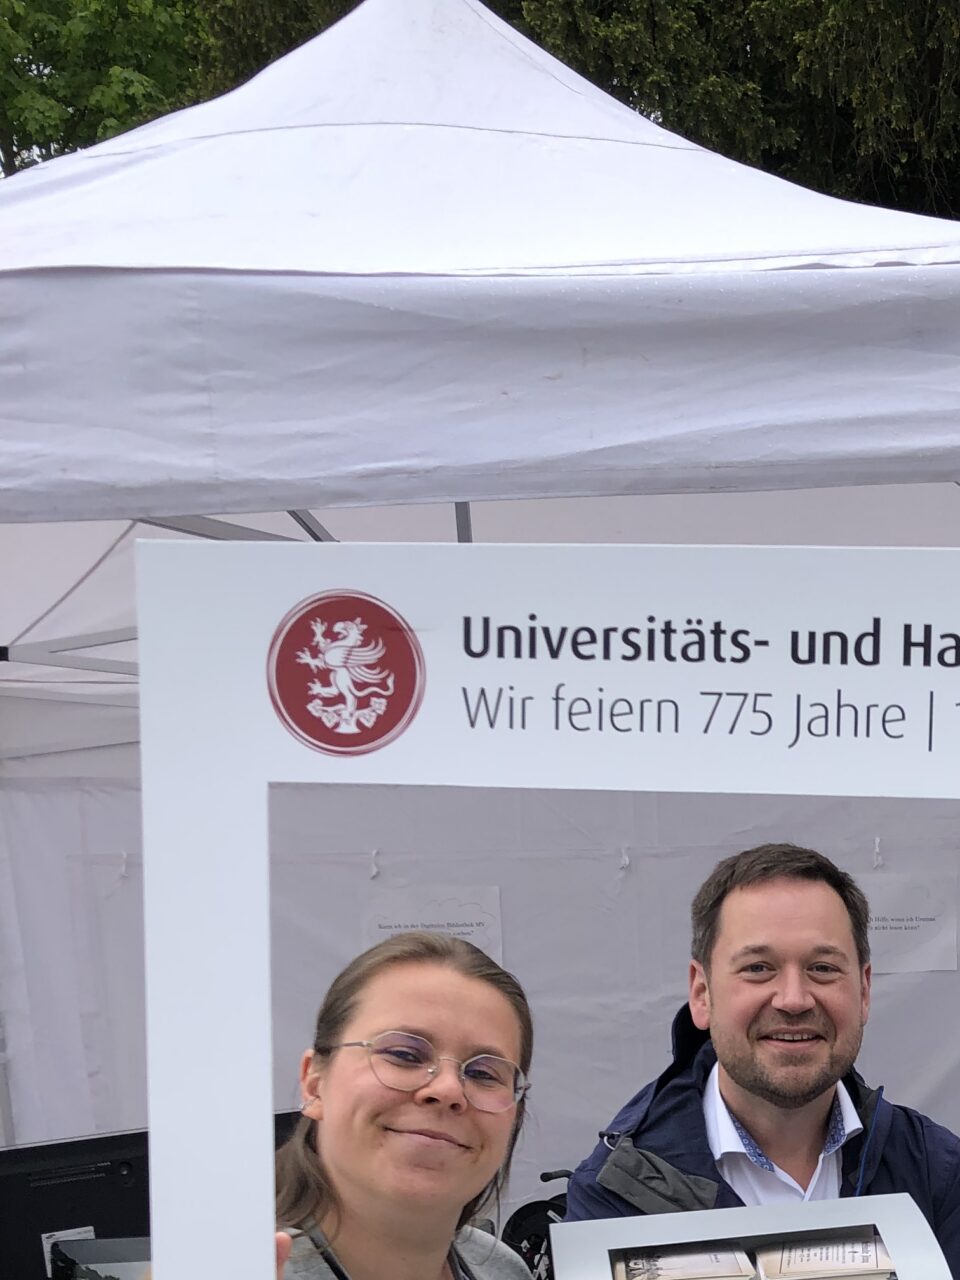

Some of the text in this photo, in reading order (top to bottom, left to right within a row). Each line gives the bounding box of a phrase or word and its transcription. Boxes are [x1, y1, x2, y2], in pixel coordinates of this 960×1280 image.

[461, 612, 771, 665] Universitäts-
[789, 615, 882, 668] und
[460, 684, 535, 731] Wir
[551, 682, 680, 734] feiern
[698, 690, 774, 737] 775
[787, 687, 907, 750] Jahre
